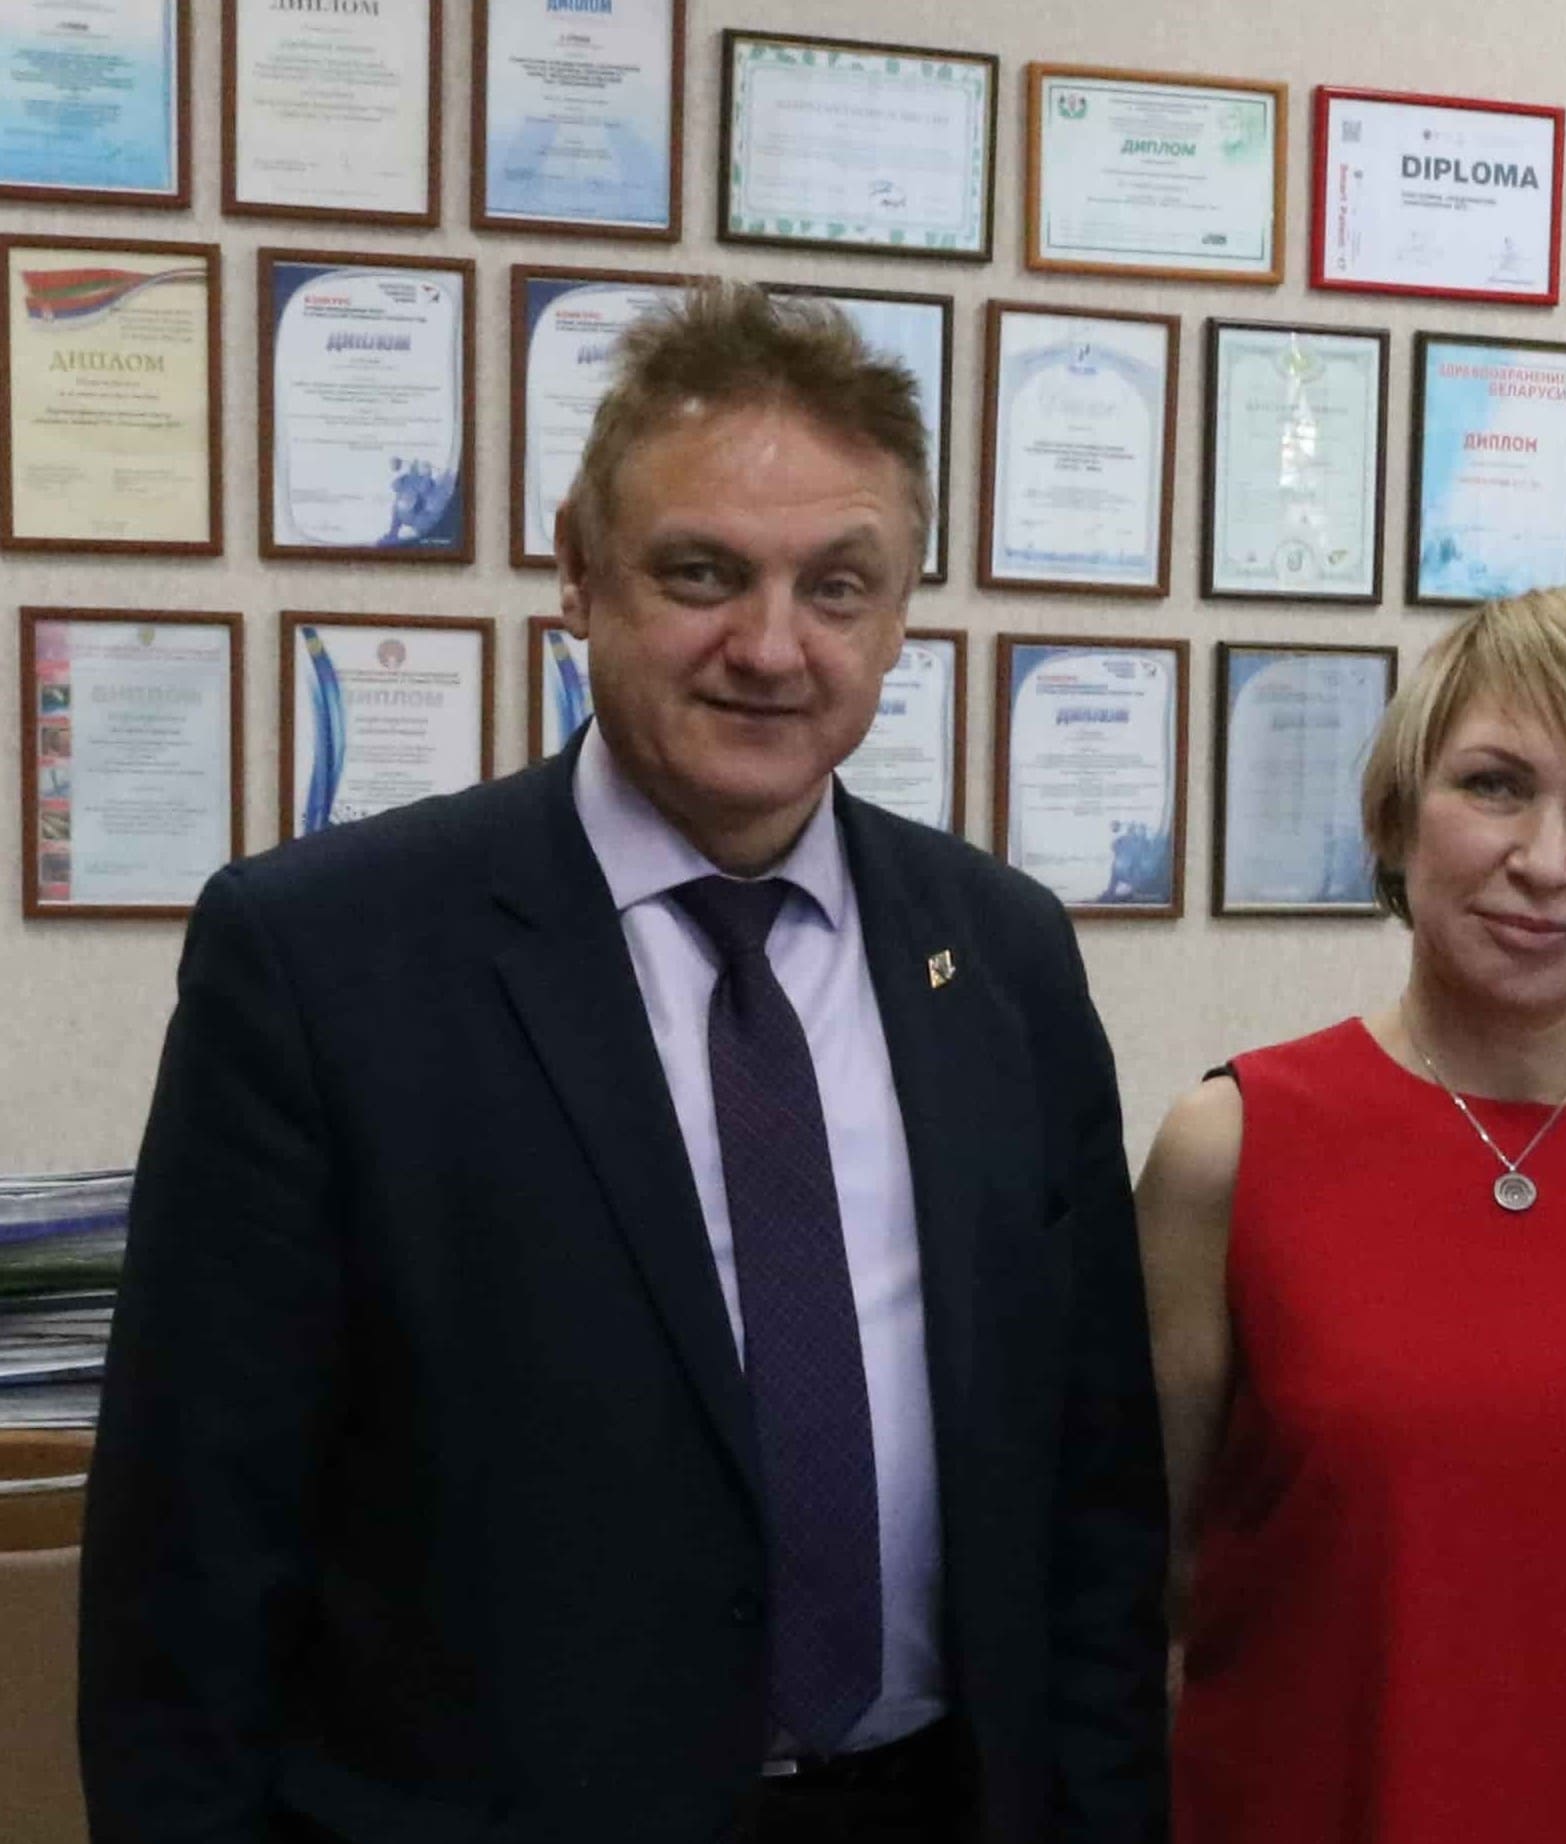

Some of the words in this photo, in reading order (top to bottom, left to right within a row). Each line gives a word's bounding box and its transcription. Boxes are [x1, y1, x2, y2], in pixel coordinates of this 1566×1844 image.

[1120, 136, 1198, 159] ДИПЛОМ
[1401, 154, 1540, 190] DIPLOMA
[49, 349, 166, 373] ДИПЛОМ
